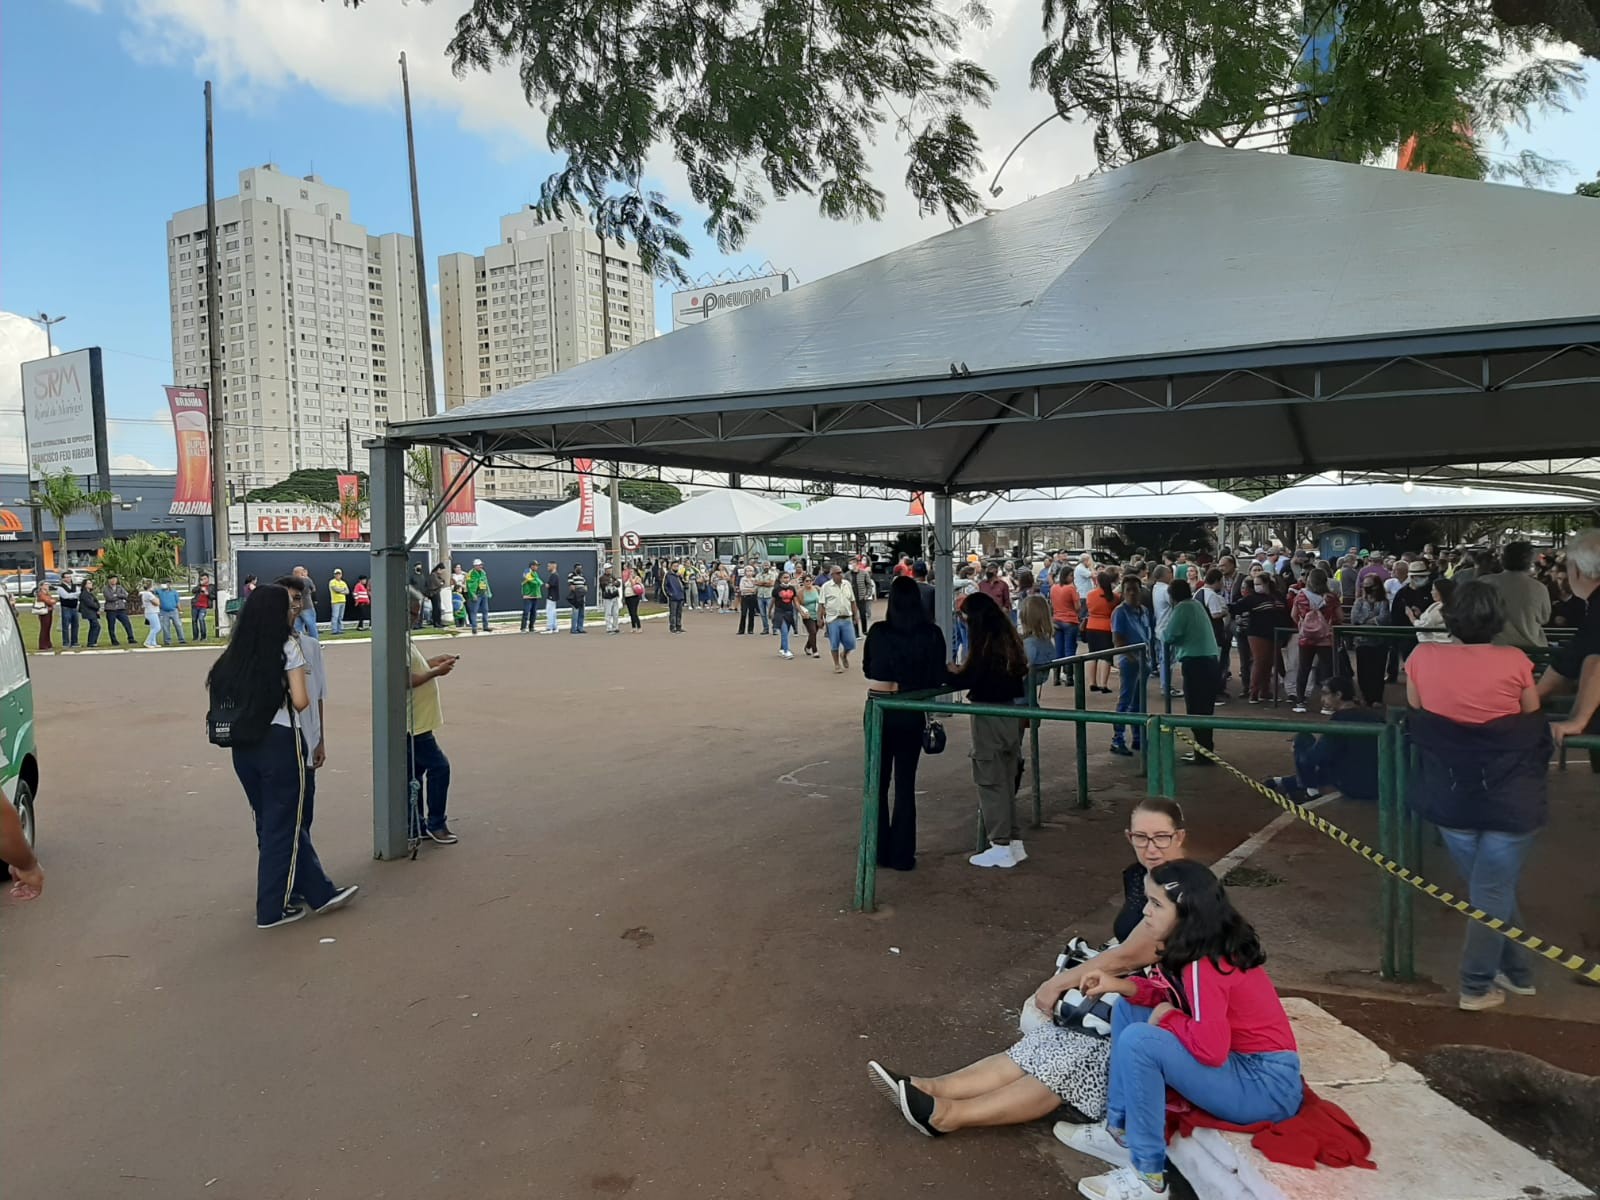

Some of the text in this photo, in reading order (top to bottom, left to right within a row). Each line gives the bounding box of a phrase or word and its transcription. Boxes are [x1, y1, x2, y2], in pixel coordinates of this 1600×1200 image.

[33, 364, 81, 400] SRM
[32, 451, 59, 465] FRANCISCO
[72, 447, 94, 460] RIBEIRO
